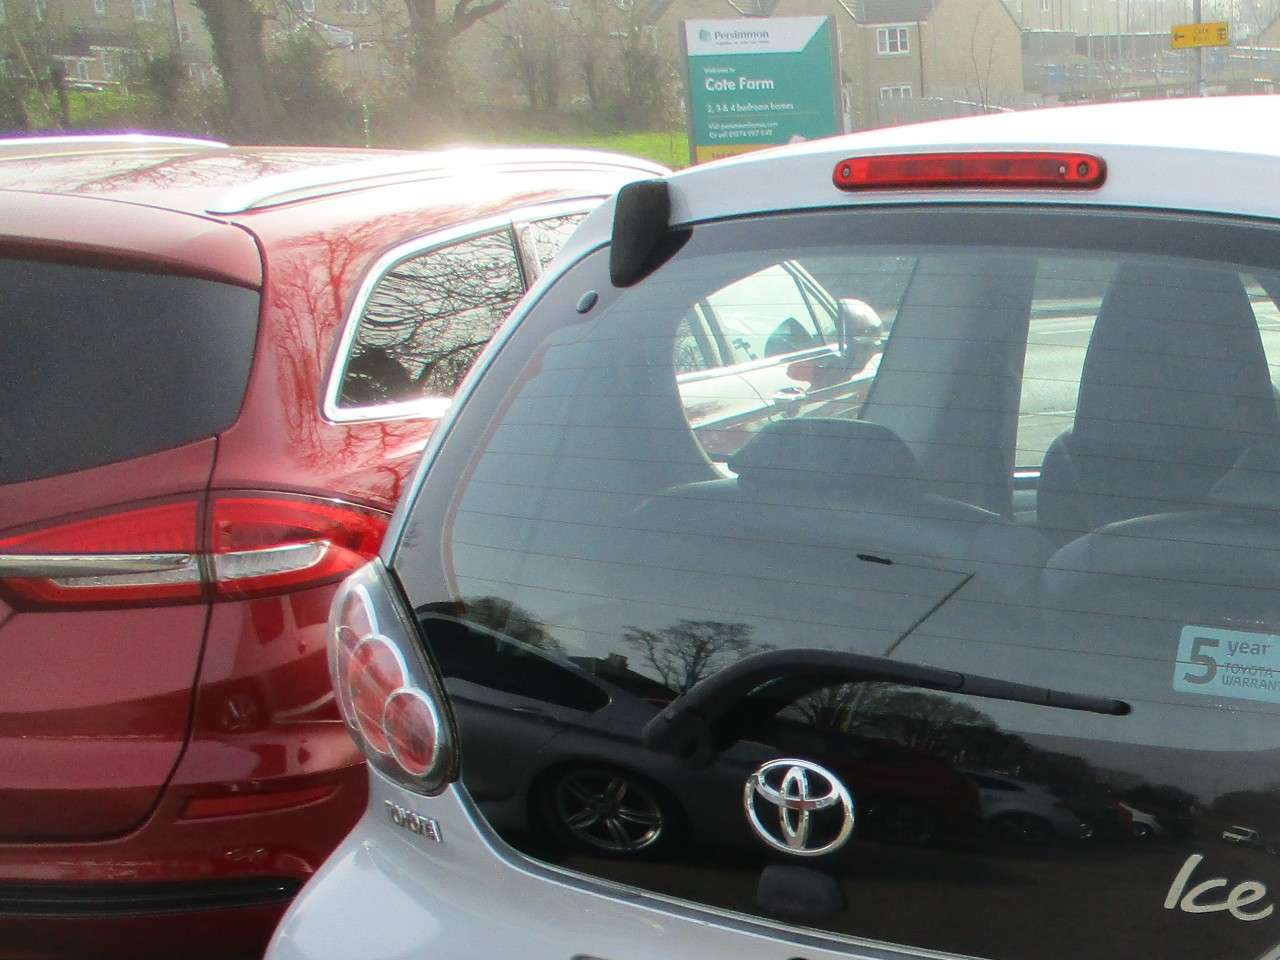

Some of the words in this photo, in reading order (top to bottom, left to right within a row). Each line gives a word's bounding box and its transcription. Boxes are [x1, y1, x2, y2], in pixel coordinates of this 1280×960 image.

[714, 30, 769, 40] Persimmon
[705, 78, 736, 91] Cote
[739, 77, 775, 90] Farm
[1183, 637, 1220, 685] 5
[1227, 640, 1270, 657] year
[1224, 662, 1273, 679] TOYOTA
[385, 799, 444, 843] TOYOTA
[1163, 854, 1274, 921] Ice
